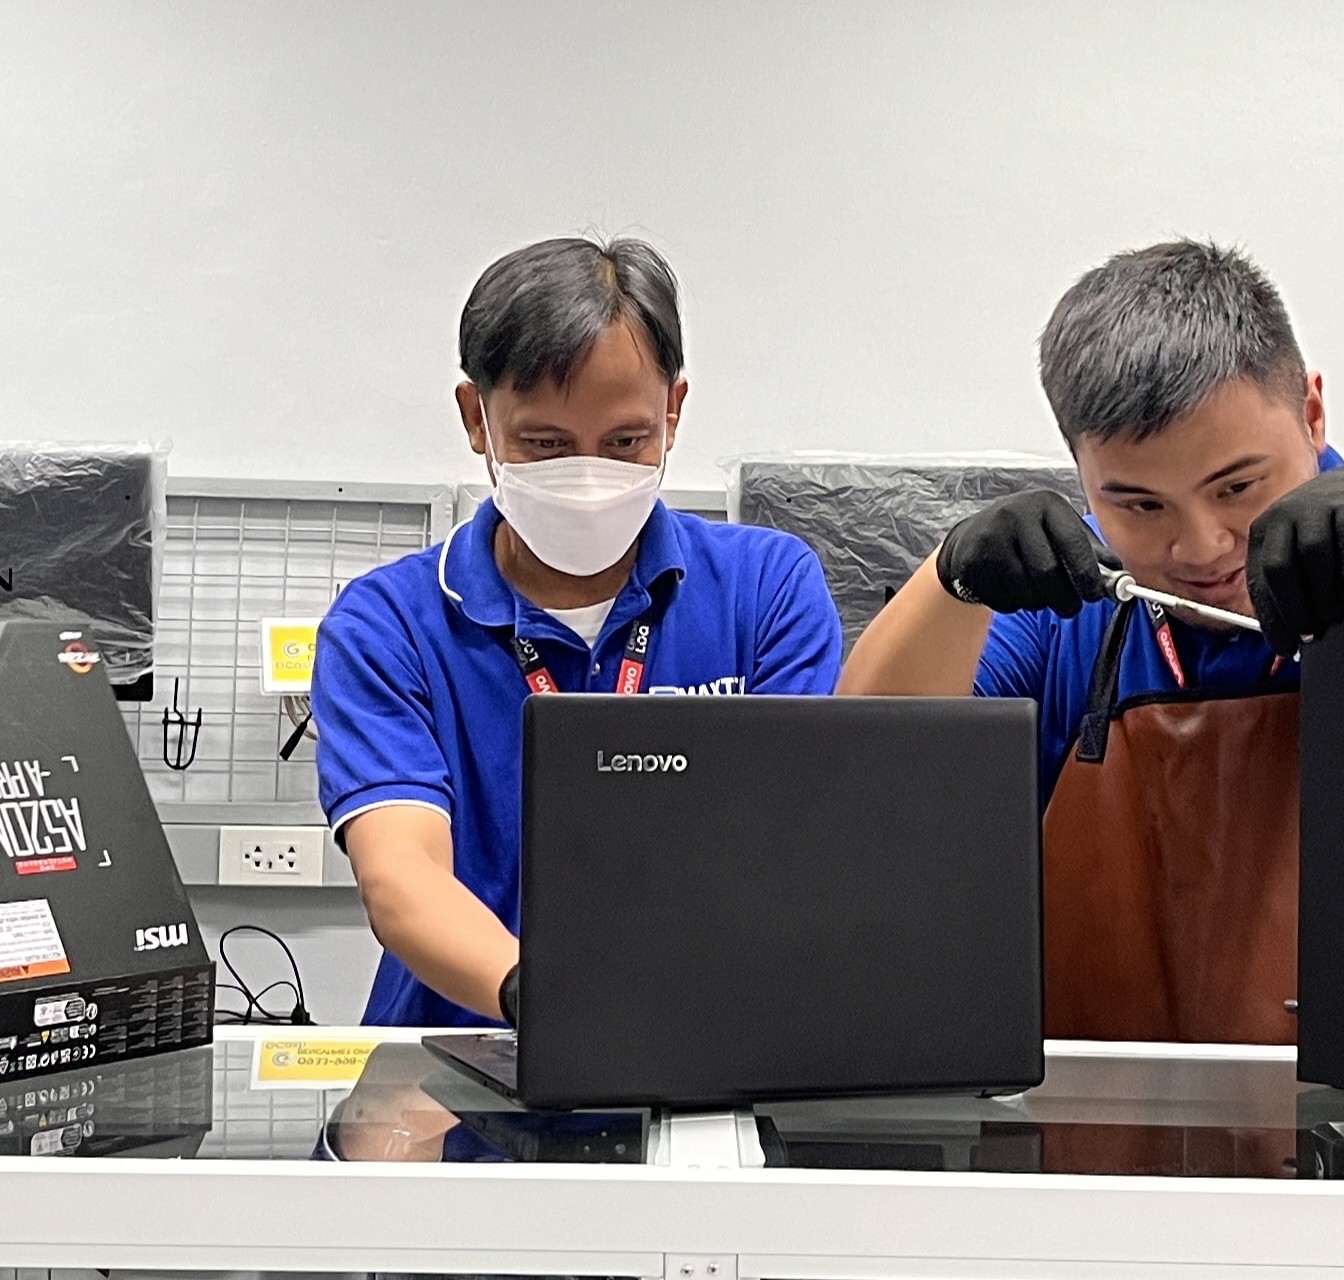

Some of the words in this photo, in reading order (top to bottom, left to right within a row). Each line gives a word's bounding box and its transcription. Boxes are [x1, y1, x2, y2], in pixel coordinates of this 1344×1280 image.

[635, 626, 650, 654] LOQ
[597, 750, 688, 772] Lenovo
[135, 923, 189, 951] msi
